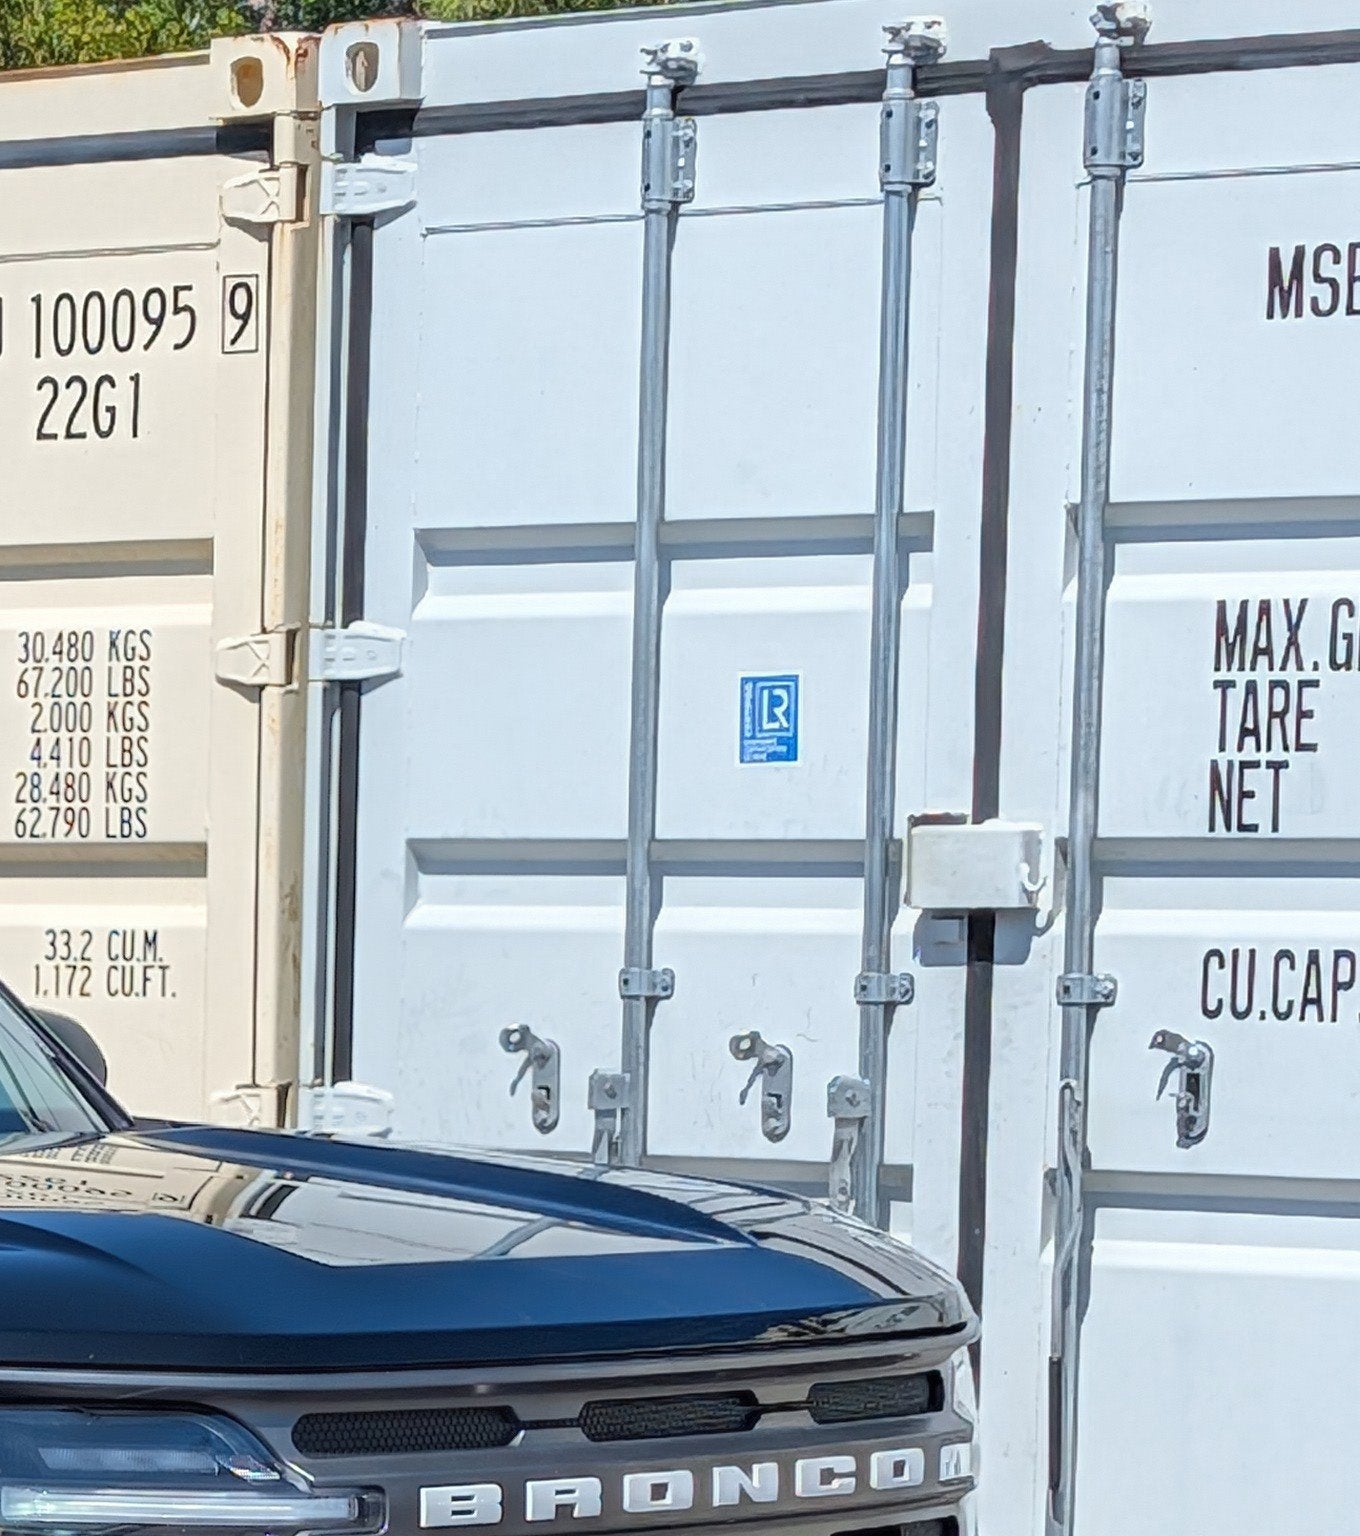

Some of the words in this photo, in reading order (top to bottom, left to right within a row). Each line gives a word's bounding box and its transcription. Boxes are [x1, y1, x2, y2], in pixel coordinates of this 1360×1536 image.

[30, 284, 197, 359] 100095
[228, 281, 254, 347] 9
[35, 372, 141, 442] 22G1
[17, 630, 94, 664] 30.480
[108, 628, 152, 663] KGS
[1213, 597, 1360, 673] MAX.G
[16, 665, 93, 699] 67.200
[107, 664, 151, 698] LBS
[30, 701, 93, 734] 2.000
[106, 700, 150, 733] KGS
[1212, 678, 1321, 754] TARE
[29, 736, 92, 769] 4.410
[105, 735, 149, 769] LBS
[15, 771, 91, 804] 28.480
[105, 771, 148, 804] KGS
[1207, 758, 1290, 834] NET
[14, 806, 91, 839] 62.790
[105, 806, 148, 839] LBS
[44, 928, 93, 962] 33.2
[34, 963, 92, 998] 1.172
[1200, 947, 1360, 1024] CU.CAP
[419, 1447, 925, 1528] BRONCO
